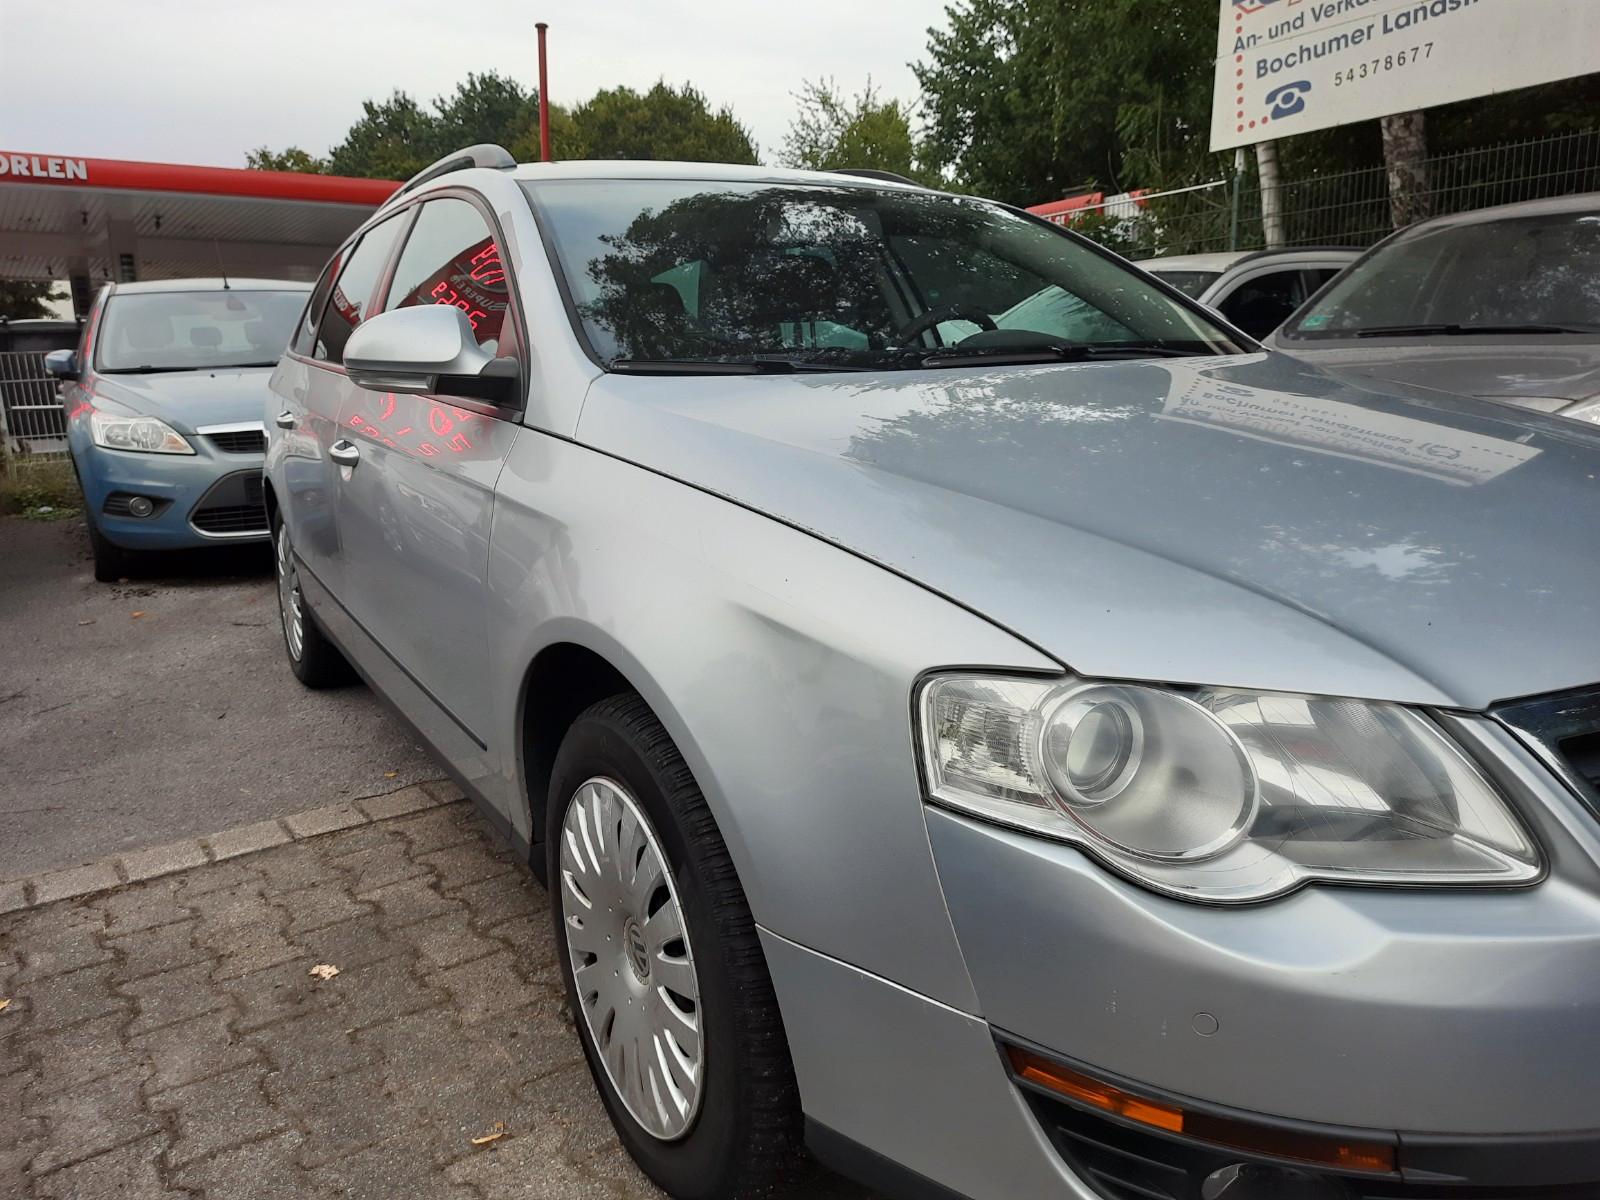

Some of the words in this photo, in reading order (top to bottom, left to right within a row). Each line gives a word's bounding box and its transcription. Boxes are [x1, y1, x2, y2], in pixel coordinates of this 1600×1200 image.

[1233, 36, 1263, 54] An-
[1268, 12, 1304, 39] und
[1311, 0, 1378, 23] Verk
[1256, 24, 1375, 79] Bochumer
[1382, 0, 1480, 34] Lands
[1334, 42, 1434, 87] 54378677
